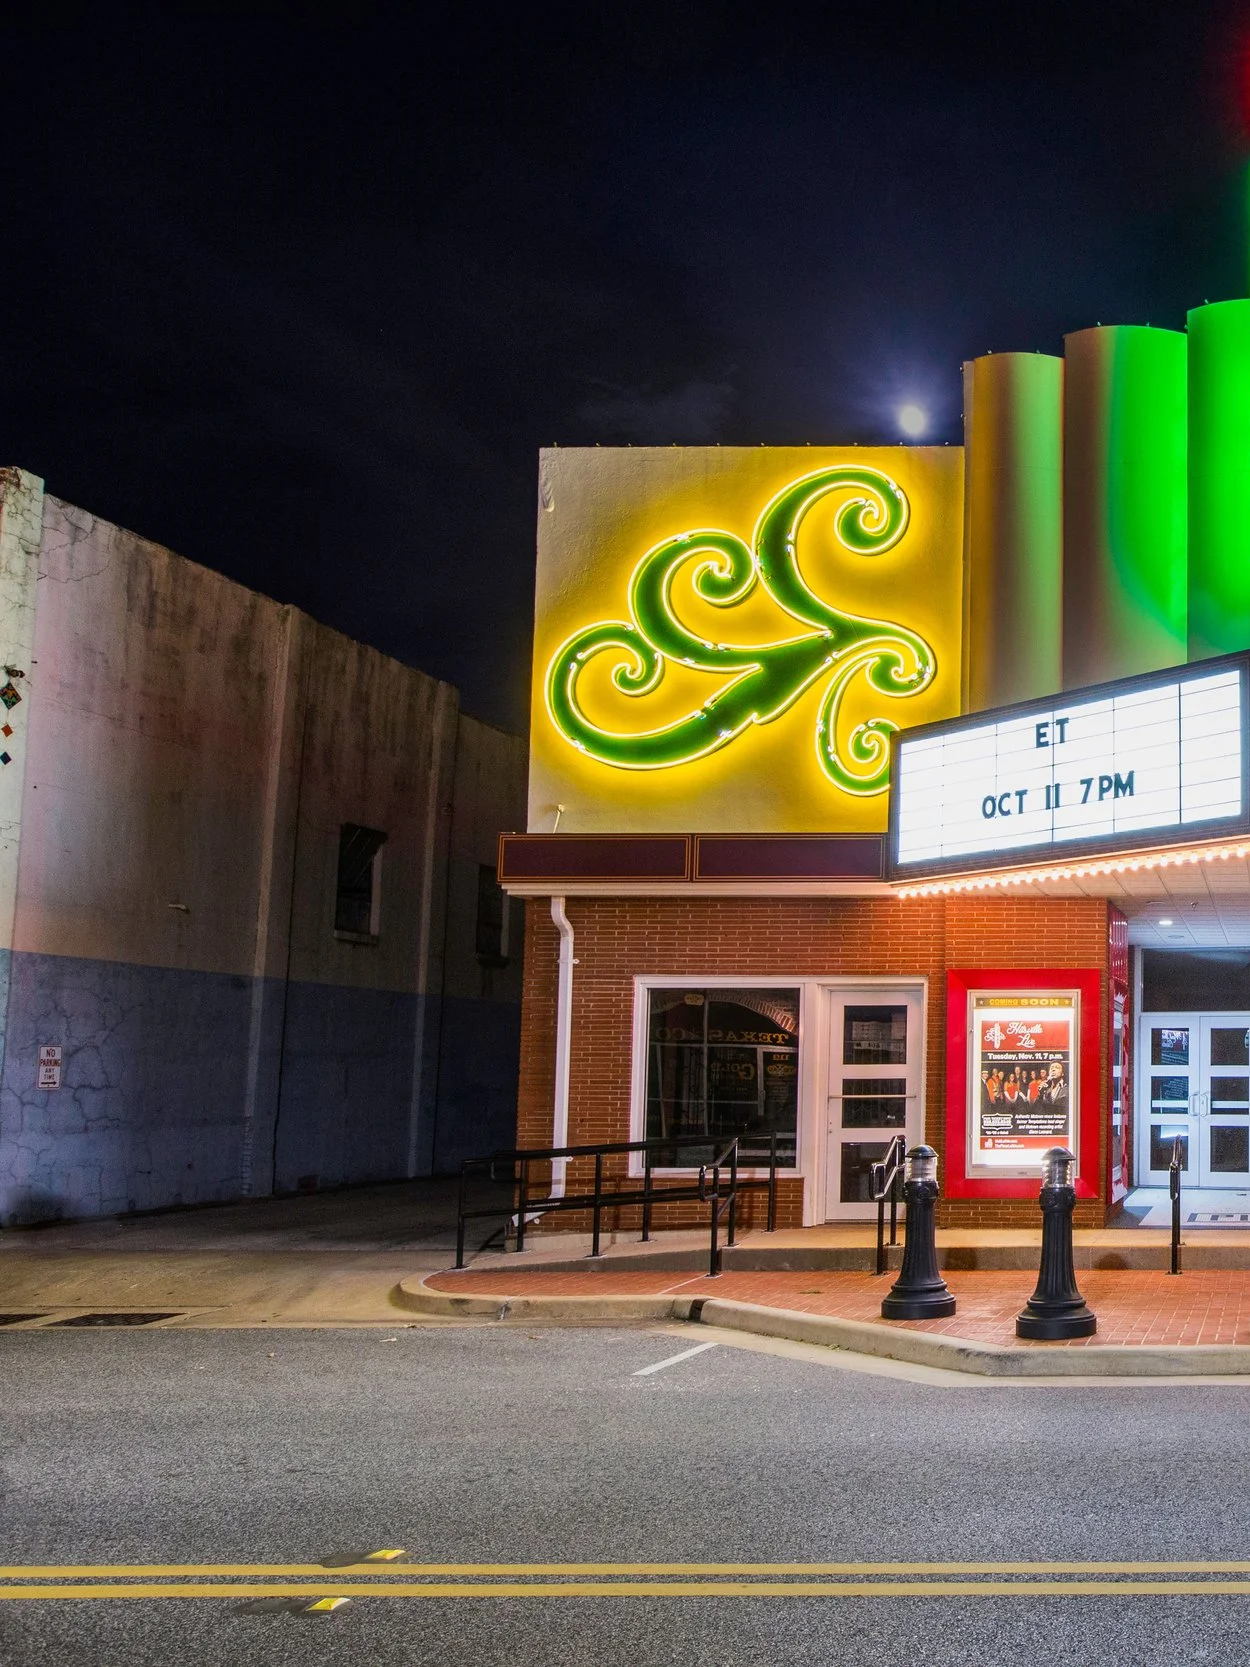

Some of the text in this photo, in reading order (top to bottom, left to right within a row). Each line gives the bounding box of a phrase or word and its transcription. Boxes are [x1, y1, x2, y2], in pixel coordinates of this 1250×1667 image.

[1035, 717, 1070, 748] ET
[981, 789, 1028, 819] OCT
[1045, 782, 1061, 810] 11
[989, 998, 1059, 1006] COMING SOON
[46, 1048, 56, 1057] NO
